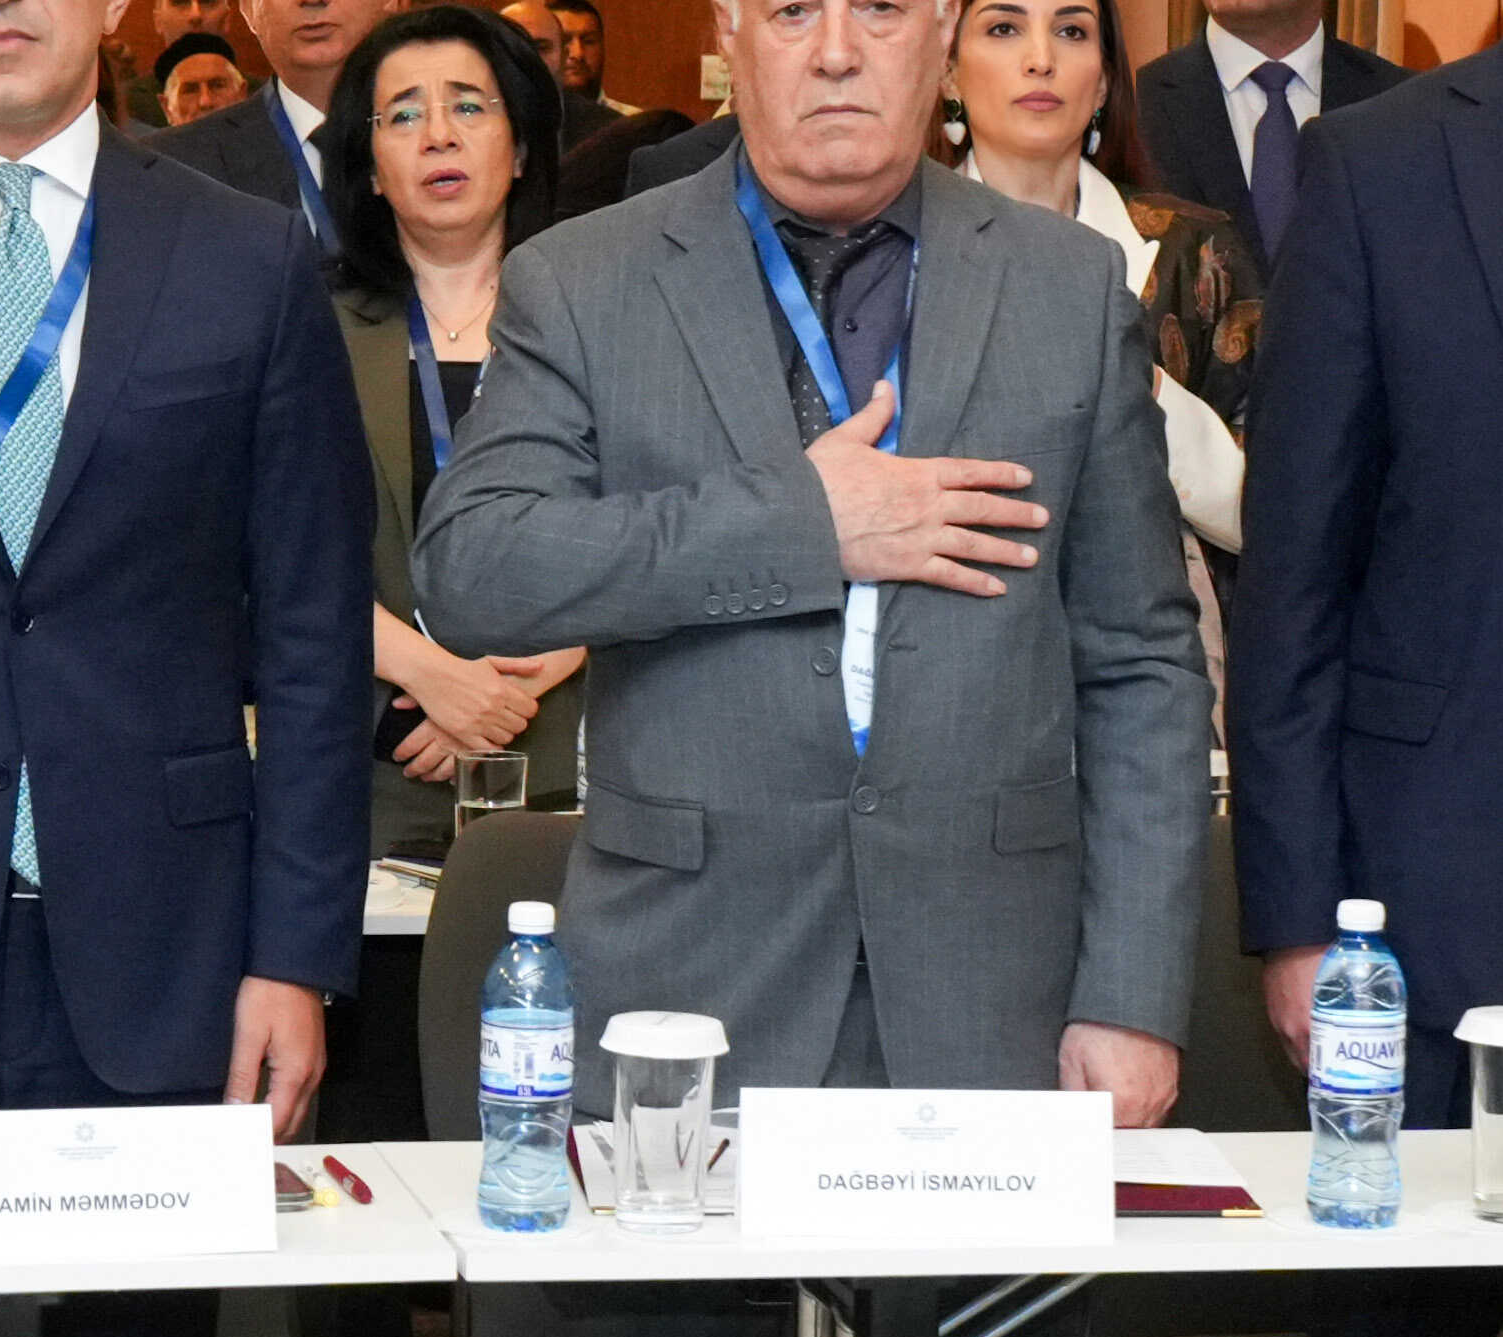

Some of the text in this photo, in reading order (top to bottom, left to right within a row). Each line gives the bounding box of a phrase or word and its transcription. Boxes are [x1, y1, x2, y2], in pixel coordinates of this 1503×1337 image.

[817, 1168, 1037, 1192] DAĞBƏYİ İSMAYILOV
[60, 1191, 191, 1213] MƏMMƏDOV
